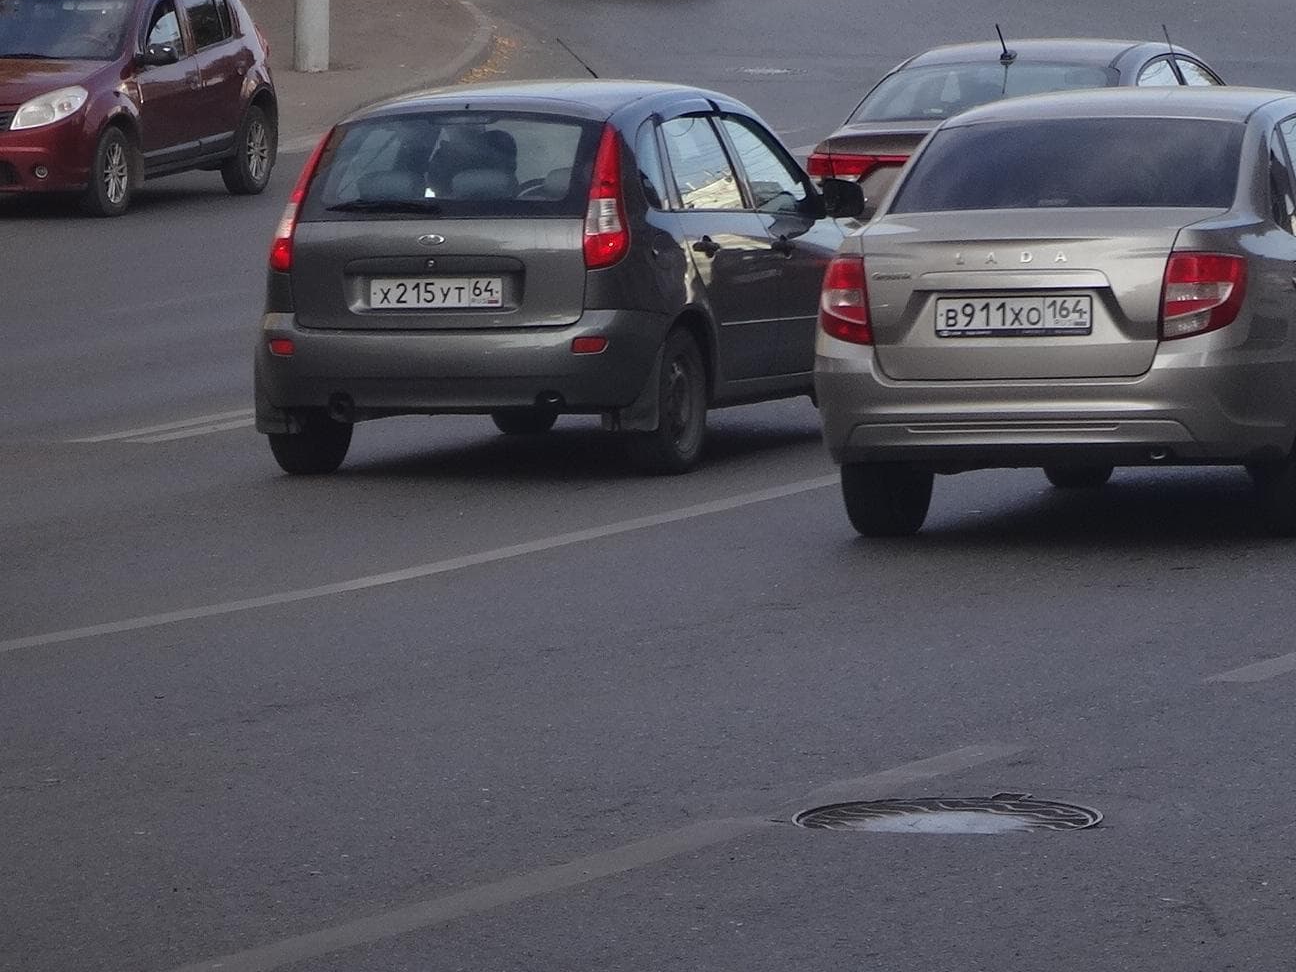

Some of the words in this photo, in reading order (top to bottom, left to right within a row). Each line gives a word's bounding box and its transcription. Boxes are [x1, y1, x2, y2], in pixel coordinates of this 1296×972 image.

[955, 251, 1068, 265] LADA
[472, 280, 494, 297] 64
[1047, 299, 1086, 319] 164
